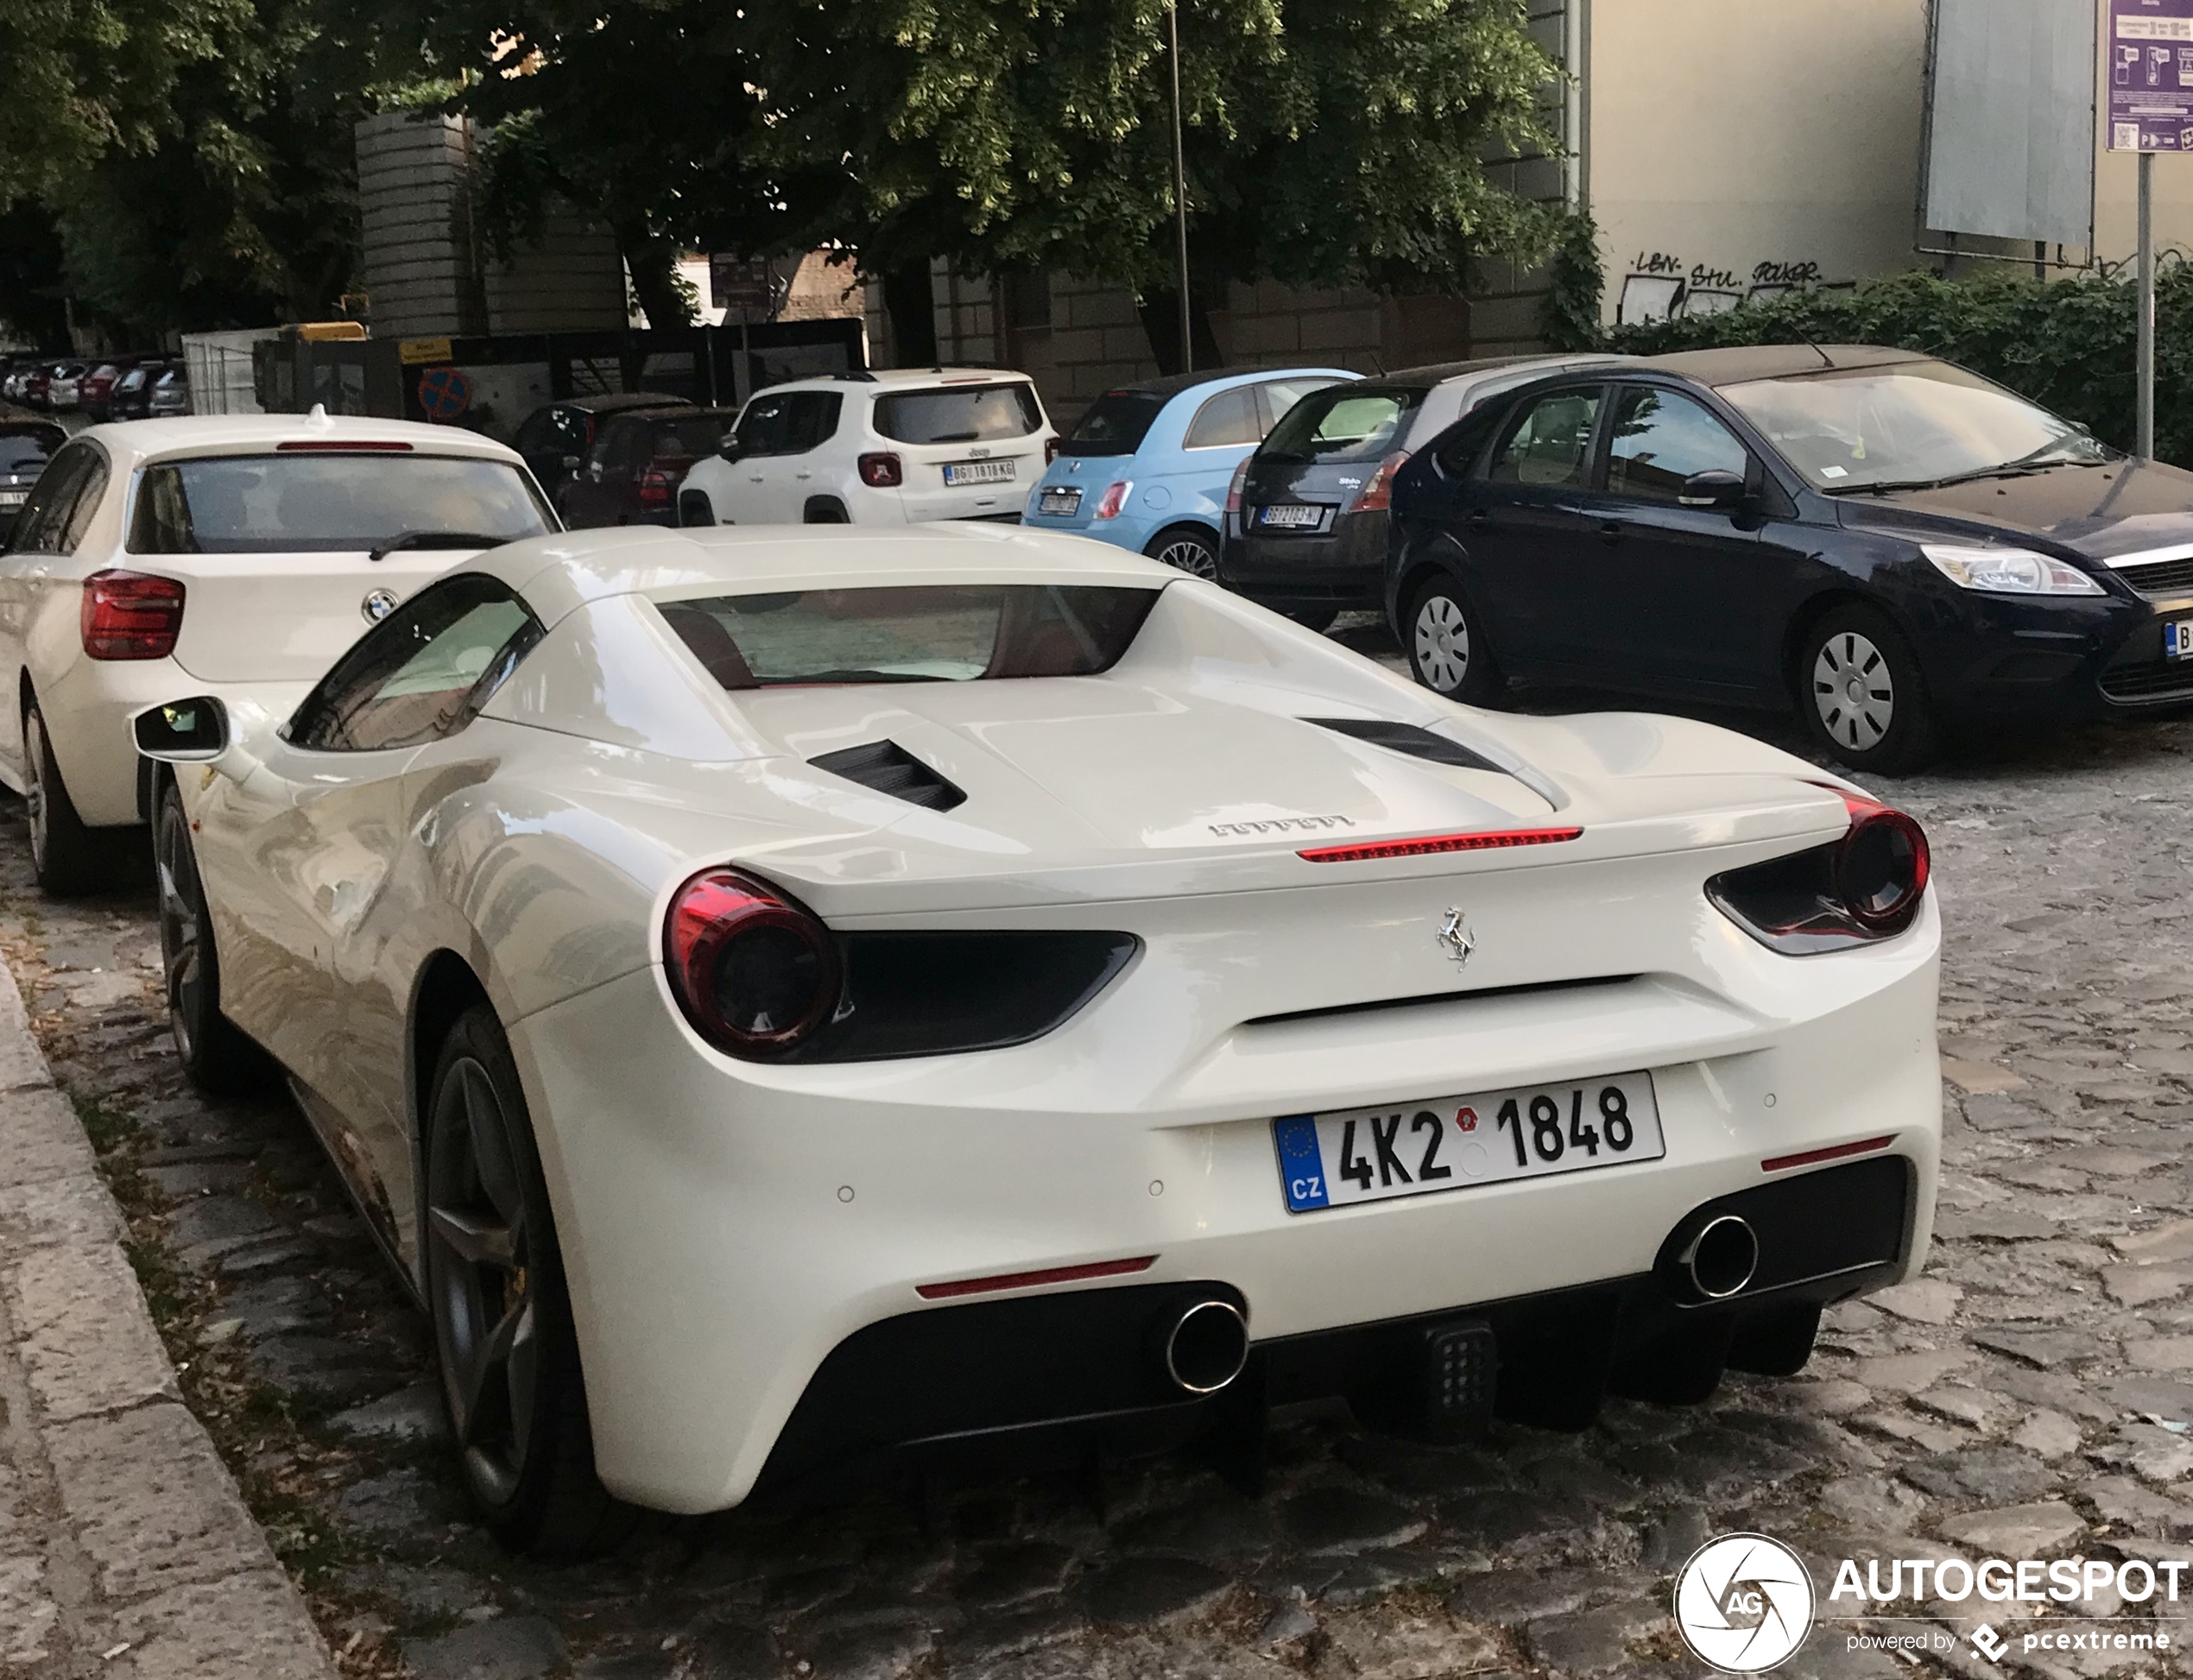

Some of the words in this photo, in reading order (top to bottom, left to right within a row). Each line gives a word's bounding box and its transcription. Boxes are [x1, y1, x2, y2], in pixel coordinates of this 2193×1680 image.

[954, 466, 967, 479] BG
[2181, 627, 2193, 650] B
[1208, 815, 1356, 837] Ferrari
[1340, 1111, 1452, 1191] 4K2
[1497, 1086, 1634, 1167] 1848
[1292, 1177, 1323, 1201] CZ
